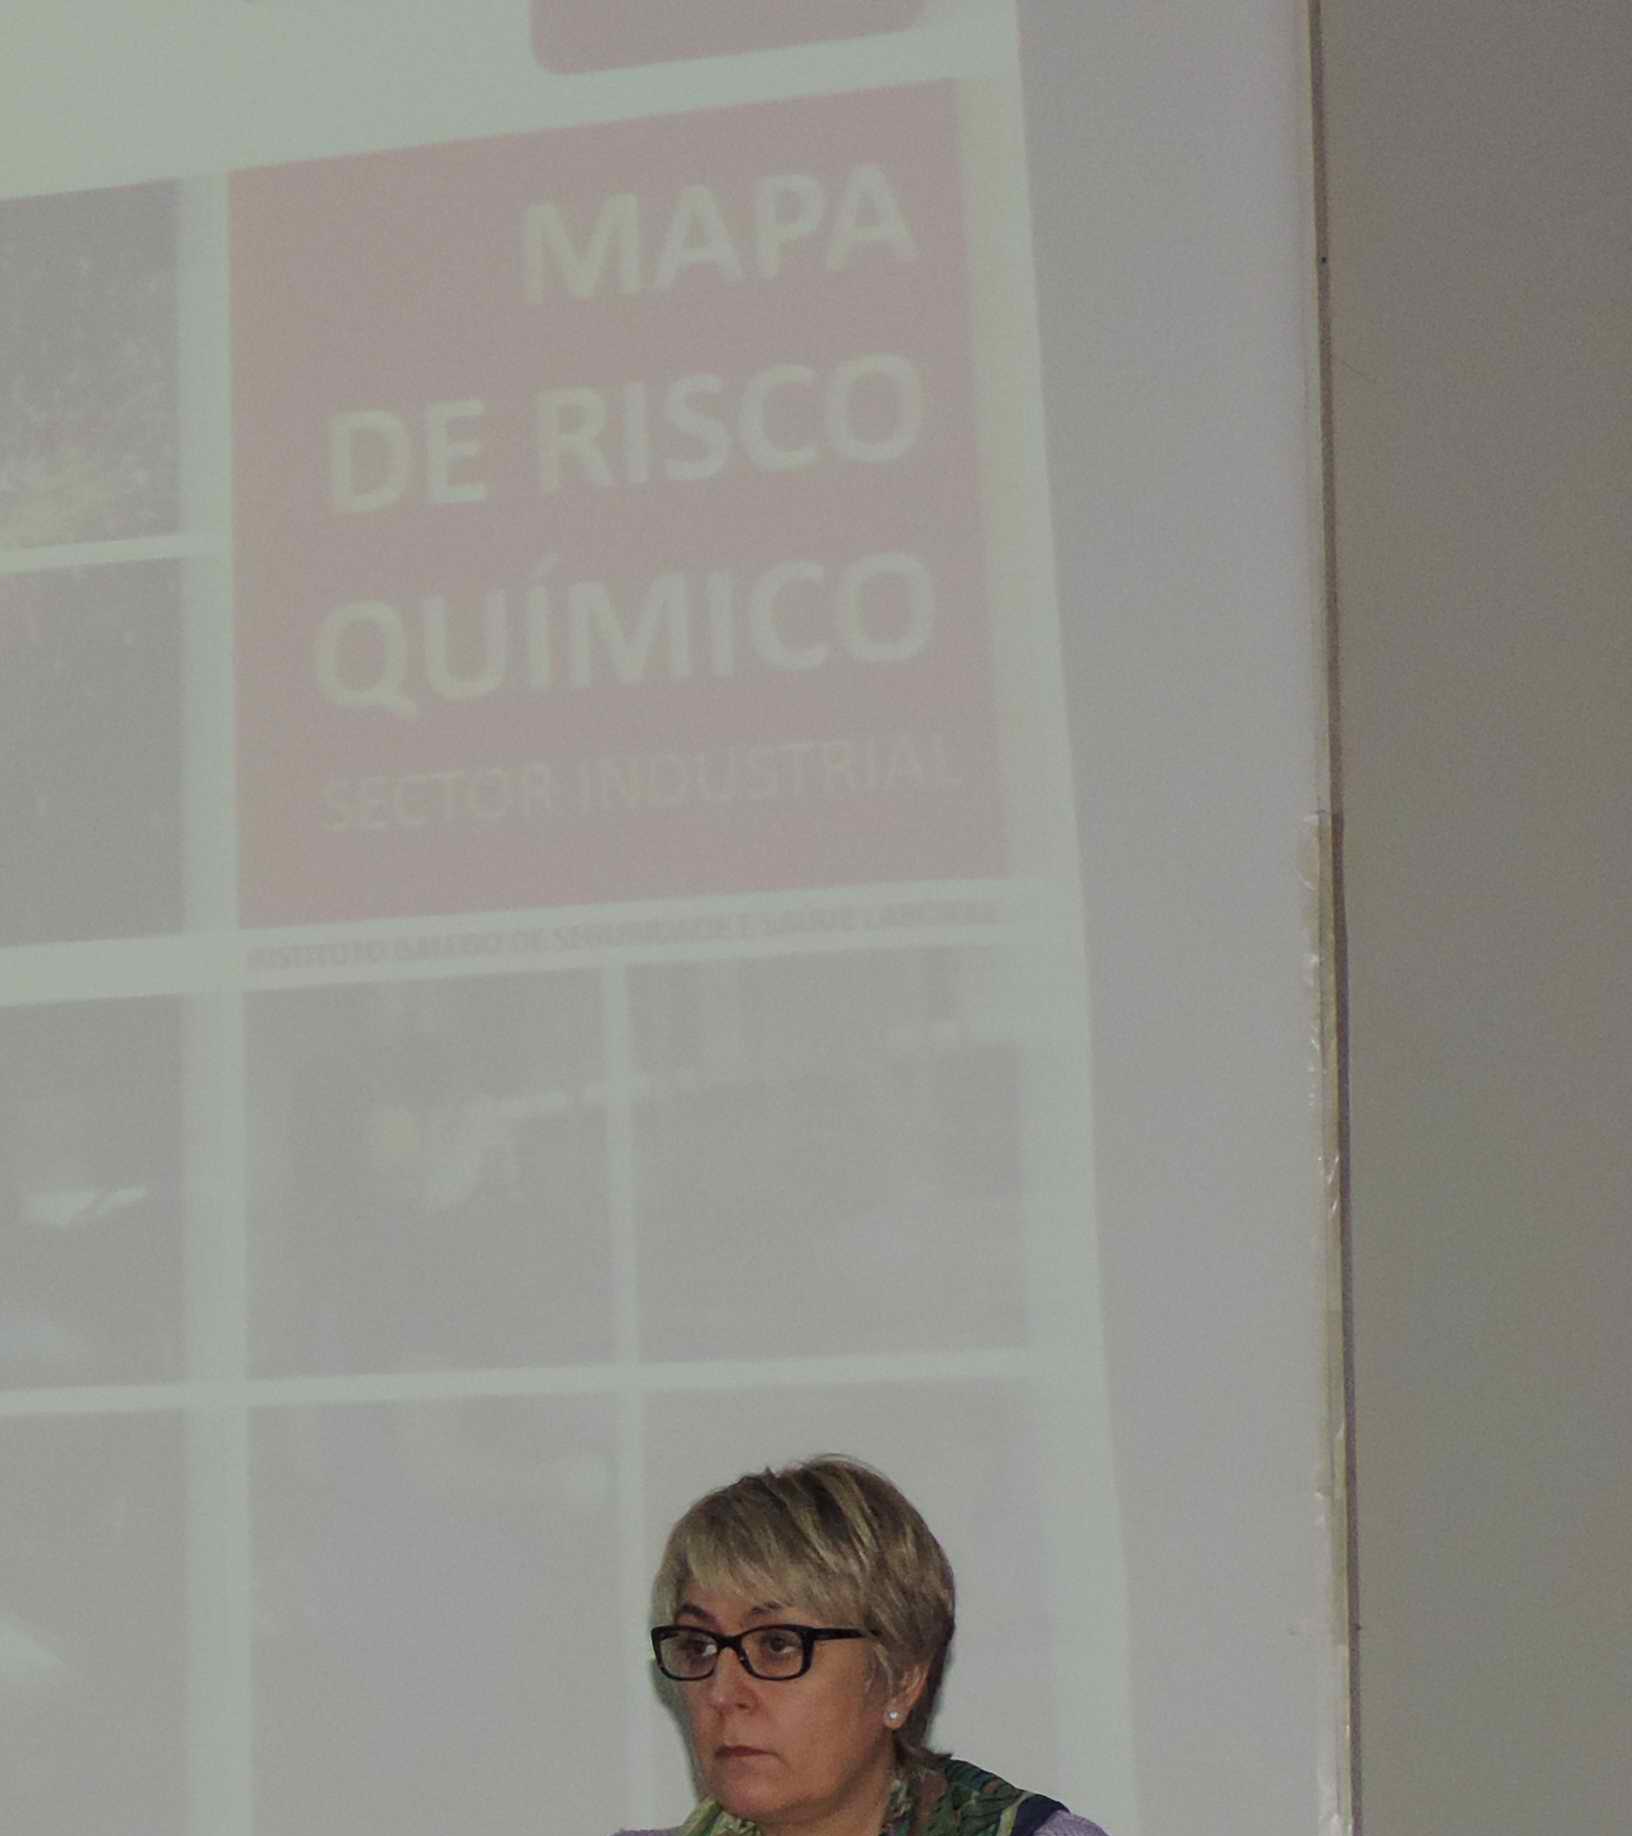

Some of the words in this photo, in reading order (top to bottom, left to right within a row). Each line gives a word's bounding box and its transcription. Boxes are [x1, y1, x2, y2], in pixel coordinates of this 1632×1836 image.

[523, 162, 918, 305] MAPA
[327, 401, 486, 514] DE
[540, 352, 923, 491] RISCO
[314, 552, 937, 719] QUÍMICO
[321, 761, 550, 832] SECTOR
[578, 733, 962, 816] INDUSTRIAL
